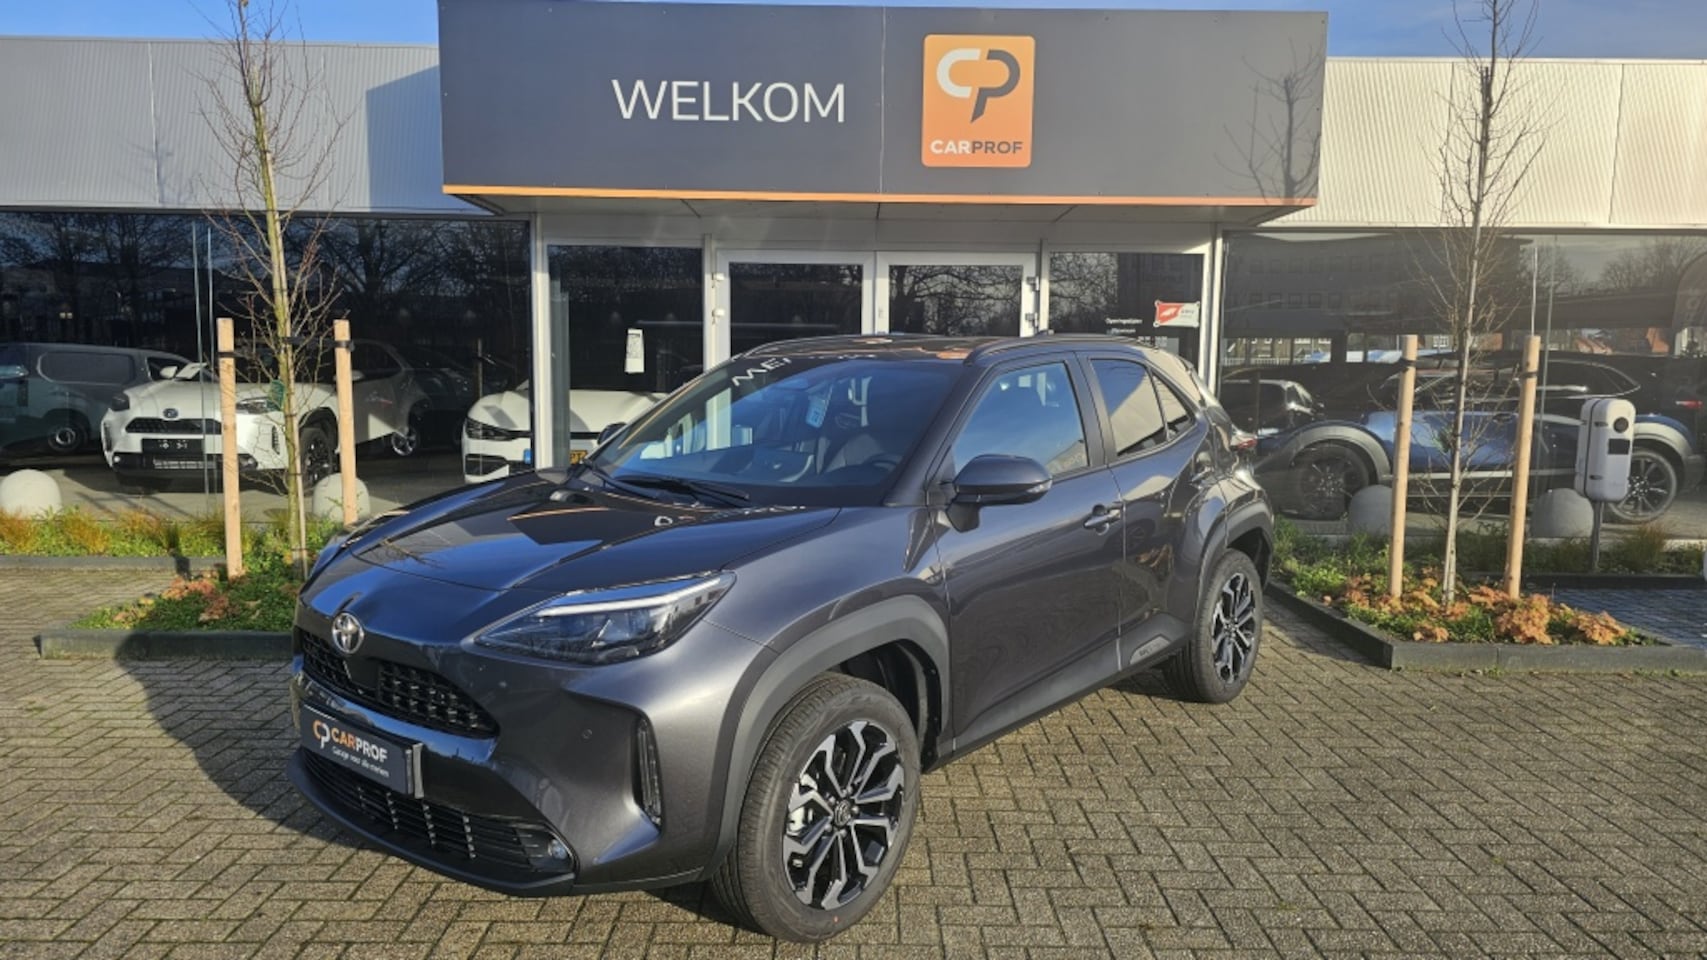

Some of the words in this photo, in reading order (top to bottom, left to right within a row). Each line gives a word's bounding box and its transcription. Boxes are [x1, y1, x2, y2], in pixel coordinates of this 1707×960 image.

[611, 79, 845, 123] WELKOM
[930, 139, 1024, 155] CARPROF
[331, 727, 388, 762] CARPROF
